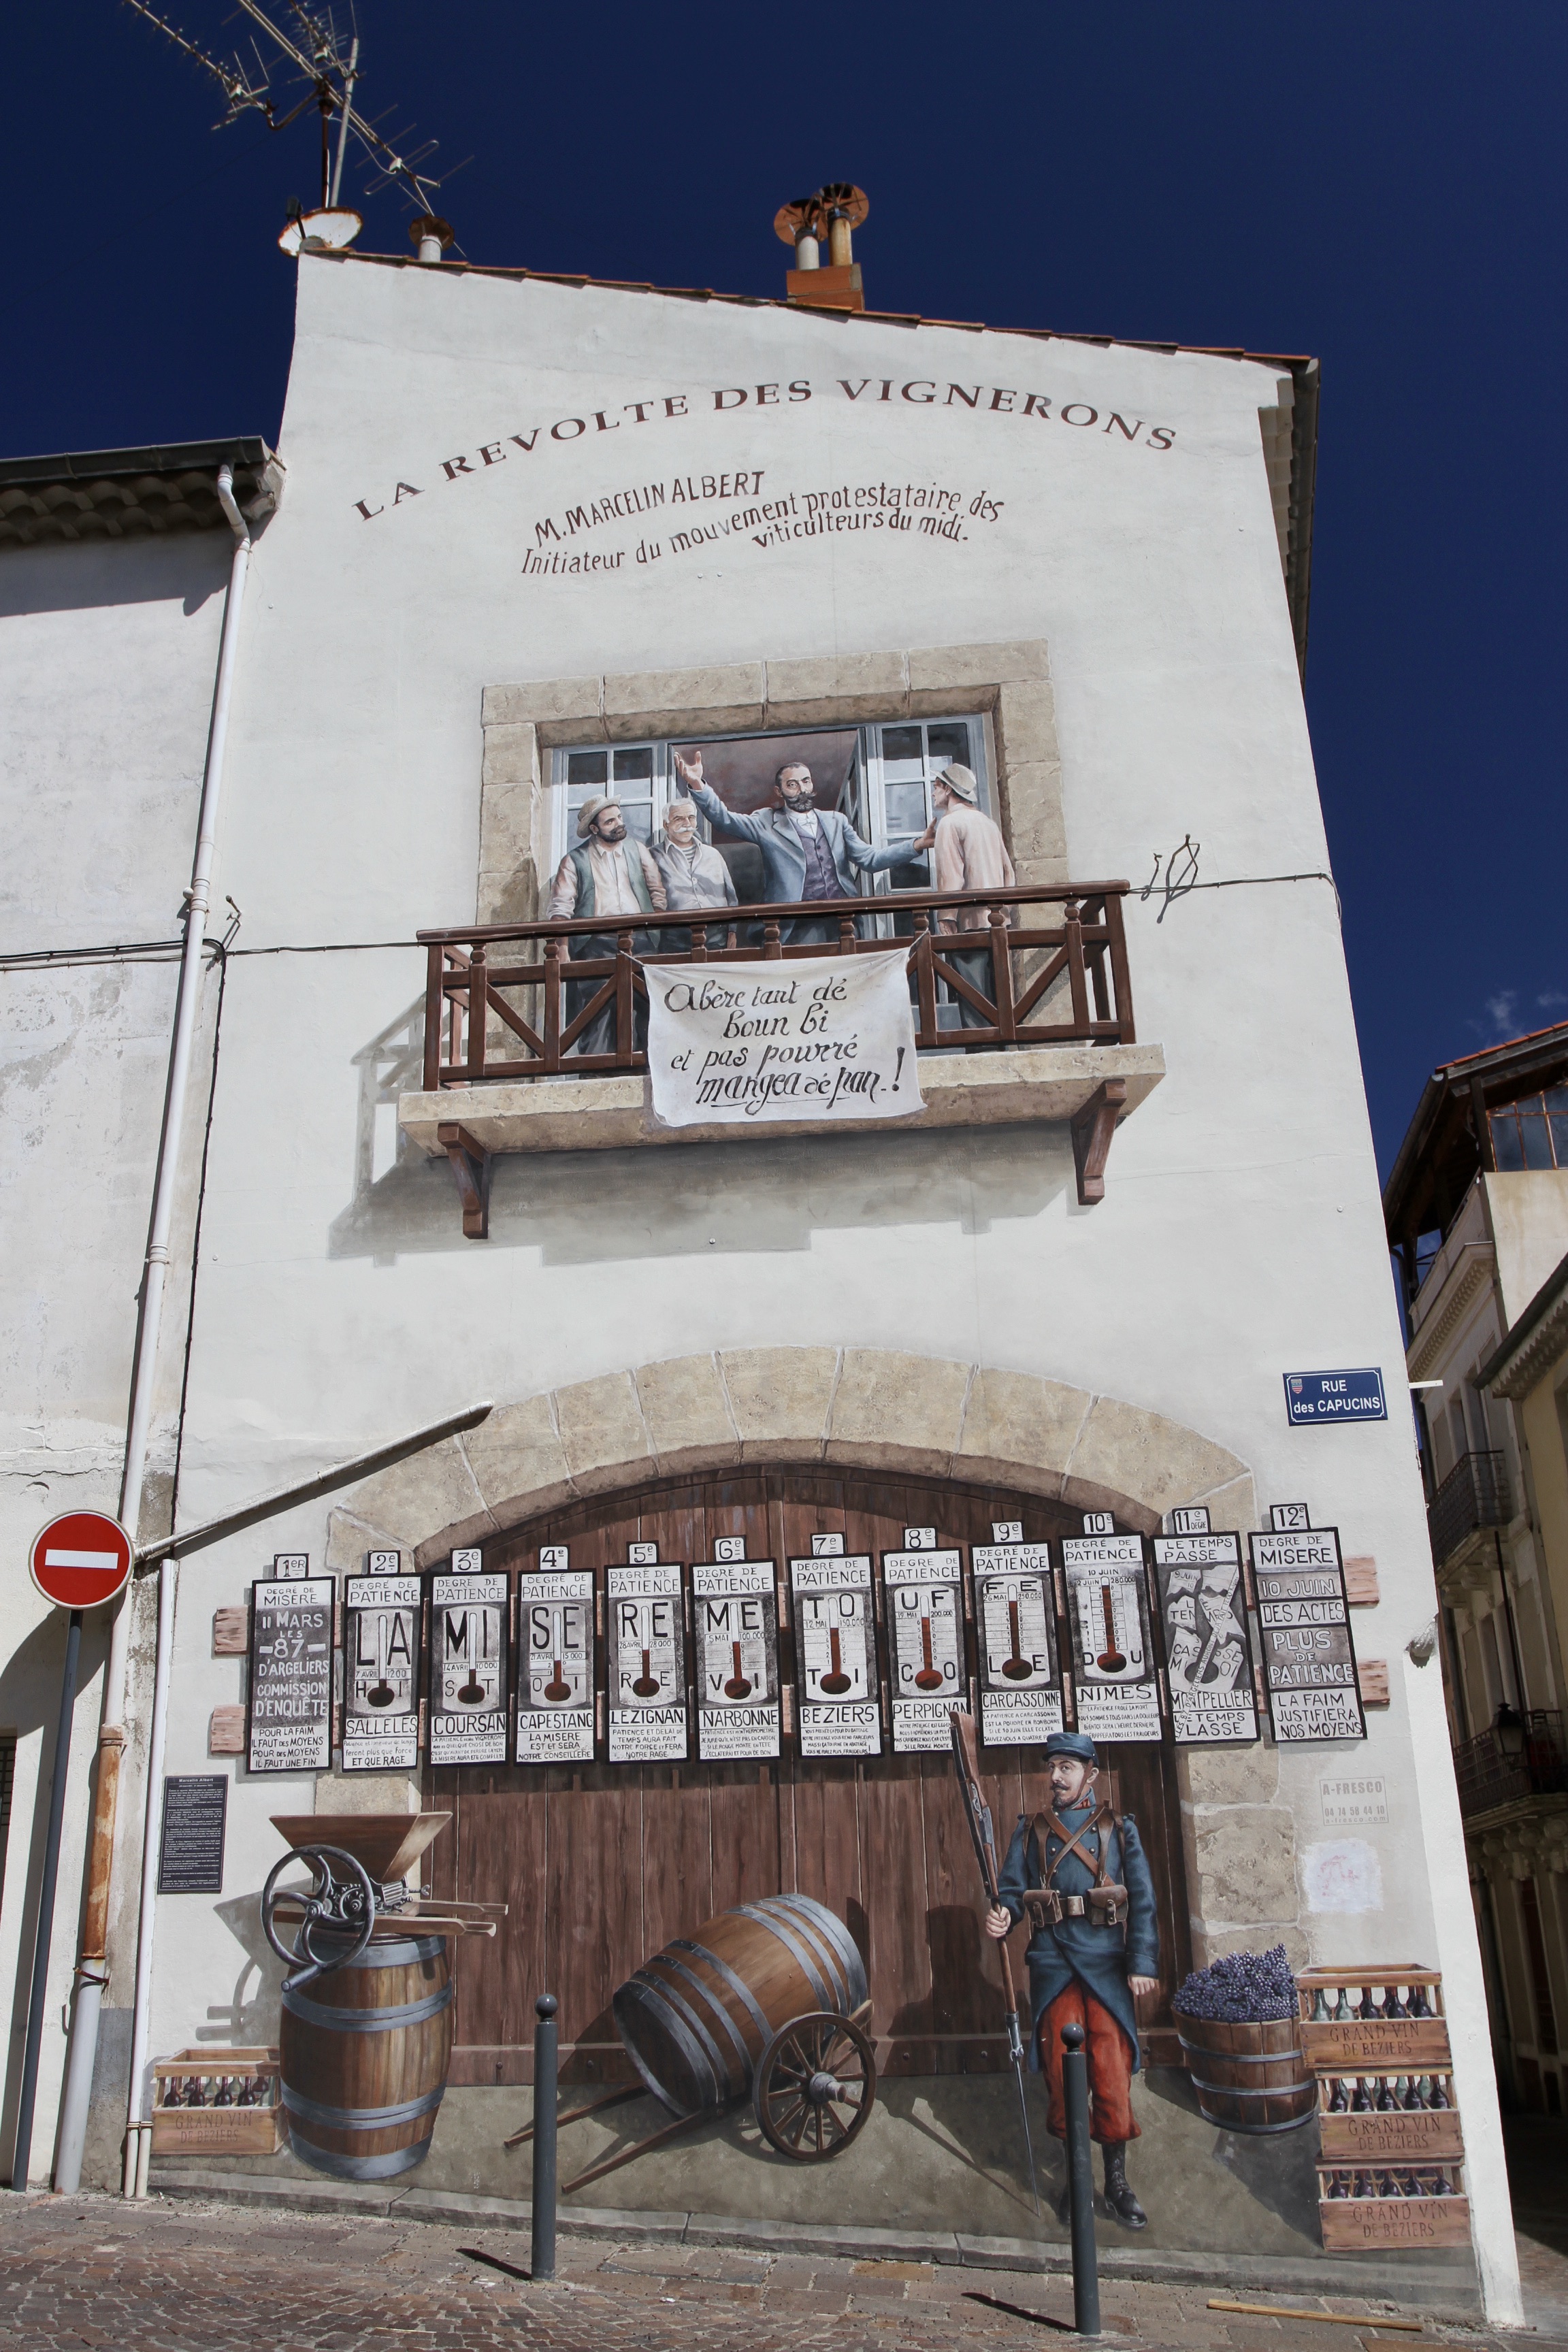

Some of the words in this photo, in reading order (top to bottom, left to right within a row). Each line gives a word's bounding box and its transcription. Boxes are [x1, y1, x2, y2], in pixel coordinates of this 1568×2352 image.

[352, 481, 425, 521] LA
[438, 395, 689, 482] REVOLTE
[711, 380, 813, 410] DES
[836, 378, 1176, 450] VIGNERONS
[671, 471, 765, 504] ALBERT
[521, 548, 625, 574] Initiateur
[636, 539, 662, 564] du
[669, 492, 799, 555] mouvement
[802, 482, 962, 519] protestataire
[970, 490, 1004, 523] des
[752, 508, 885, 548] viticulteurs
[889, 507, 911, 531] du
[917, 511, 968, 542] midi.
[751, 980, 802, 1007] tant
[813, 977, 847, 1002] dé
[723, 1009, 789, 1039] boun
[800, 1002, 829, 1034] bi
[670, 1050, 693, 1071] et
[697, 1047, 749, 1085] pas
[757, 1034, 858, 1078] pourré
[697, 1072, 800, 1115] mangea
[804, 1072, 830, 1094] dé
[1322, 1379, 1347, 1392] RUE
[1293, 1402, 1314, 1414] des
[1318, 1396, 1380, 1411] CAPUCINS
[1167, 1541, 1184, 1550] LE
[1191, 1538, 1232, 1548] TEMPS
[1260, 1536, 1300, 1547] DEGRE
[1307, 1535, 1324, 1544] DE
[1066, 1548, 1137, 1561] PATIENCE
[1164, 1550, 1217, 1562] PASSE
[1261, 1548, 1333, 1565] MISERE
[977, 1556, 1046, 1571] PATIENCE
[797, 1569, 866, 1586] PATIENCE
[889, 1567, 959, 1580] PATIENCE
[267, 1586, 297, 1595] DEGRÉ
[522, 1584, 586, 1599] PATIENCE
[610, 1579, 679, 1592] PATIENCE
[698, 1577, 770, 1591] PATIENCE
[1287, 1578, 1335, 1597] JUIN
[264, 1593, 318, 1606] MISERE
[350, 1590, 419, 1603] PATIENCE
[436, 1588, 504, 1601] PATIENCE
[1263, 1603, 1294, 1622] DES
[1298, 1601, 1345, 1622] ACTES
[276, 1611, 324, 1628] MARS
[1272, 1629, 1331, 1650] PLUS
[1294, 1652, 1316, 1662] DE
[259, 1659, 329, 1677] D'ARGELIERS
[1270, 1663, 1354, 1685] PATIENCE
[983, 1691, 1061, 1708] CARCASSONNE
[1077, 1684, 1152, 1702] NIMES
[1279, 1694, 1298, 1708] LA
[1305, 1693, 1345, 1706] FAIM
[255, 1697, 328, 1718] D'ENQUÊTE
[802, 1705, 875, 1725] BEZIERS
[1277, 1708, 1358, 1722] JUSTIFIERA
[520, 1712, 593, 1730] CAPESTANG
[610, 1709, 683, 1724] LEZIGNAN
[703, 1709, 779, 1727] NARBONNE
[1196, 1712, 1245, 1722] TEMPS
[259, 1729, 281, 1737] POUR
[295, 1727, 314, 1735] FAIM
[346, 1716, 418, 1735] SALLELES
[434, 1714, 506, 1735] COURSAN
[1186, 1722, 1243, 1736] LASSE
[1280, 1725, 1305, 1739] NOS
[1309, 1722, 1362, 1737] MOYENS
[252, 1739, 257, 1748] IL
[259, 1739, 278, 1748] FAUT
[290, 1737, 323, 1746] MOYENS
[529, 1733, 541, 1742] LA
[544, 1732, 581, 1742] MISERE
[287, 1748, 320, 1757] MOYENS
[346, 1749, 364, 1757] feront
[367, 1748, 380, 1757] plus
[382, 1748, 393, 1757] que
[544, 1750, 591, 1759] CONSEILLERE
[264, 1759, 284, 1768] FAUT
[303, 1758, 316, 1766] FIN
[352, 1758, 363, 1766] ET
[364, 1757, 381, 1766] QUE
[382, 1756, 406, 1766] RAGE
[1323, 1781, 1383, 1795] A-FRESCO
[1325, 1808, 1334, 1816] 04
[1338, 1807, 1346, 1816] 74
[1350, 1806, 1360, 1816] 58
[1363, 1806, 1373, 1815] 44
[1376, 1806, 1385, 1814] 10
[1330, 2025, 1386, 2042] GRAND
[1390, 2023, 1419, 2038] VIN
[1343, 2042, 1358, 2056] DE
[1362, 2041, 1412, 2055] BEZIERS
[176, 2114, 223, 2129] GRAND
[227, 2111, 252, 2126] VIN
[1348, 2118, 1405, 2136] GRAND
[1412, 2117, 1441, 2132] VIN
[181, 2131, 193, 2144] DE
[197, 2129, 239, 2142] BEZIERS
[1358, 2137, 1375, 2151] DE
[1379, 2134, 1429, 2149] BEZIERS
[1353, 2204, 1411, 2223] GRAND
[1419, 2203, 1448, 2219] VIN
[1363, 2223, 1379, 2238] DE
[1384, 2223, 1435, 2237] BEZIERS
